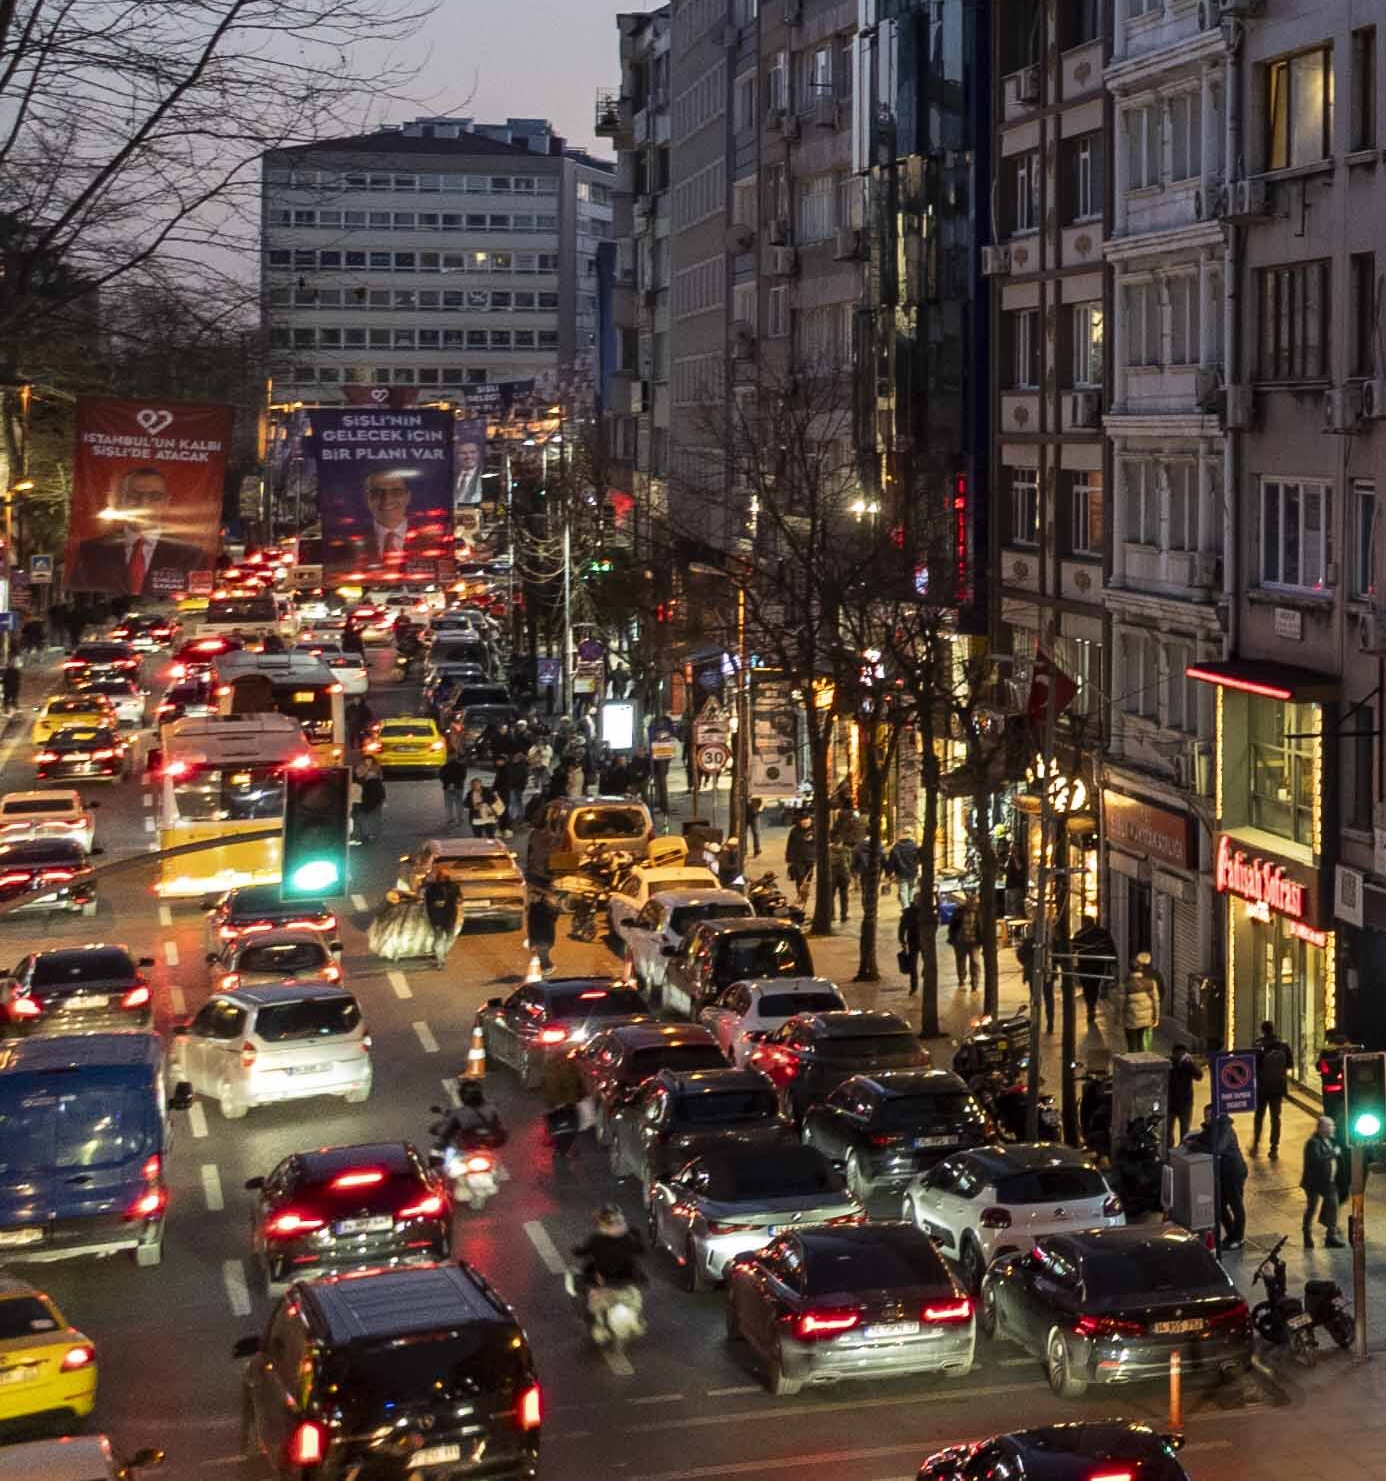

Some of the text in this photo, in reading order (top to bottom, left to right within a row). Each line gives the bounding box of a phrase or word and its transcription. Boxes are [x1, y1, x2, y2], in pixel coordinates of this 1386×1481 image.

[322, 430, 402, 441] GELECEK
[154, 449, 209, 462] ATACAK
[321, 448, 444, 460] BİR PLANI VAR
[704, 751, 724, 765] 30
